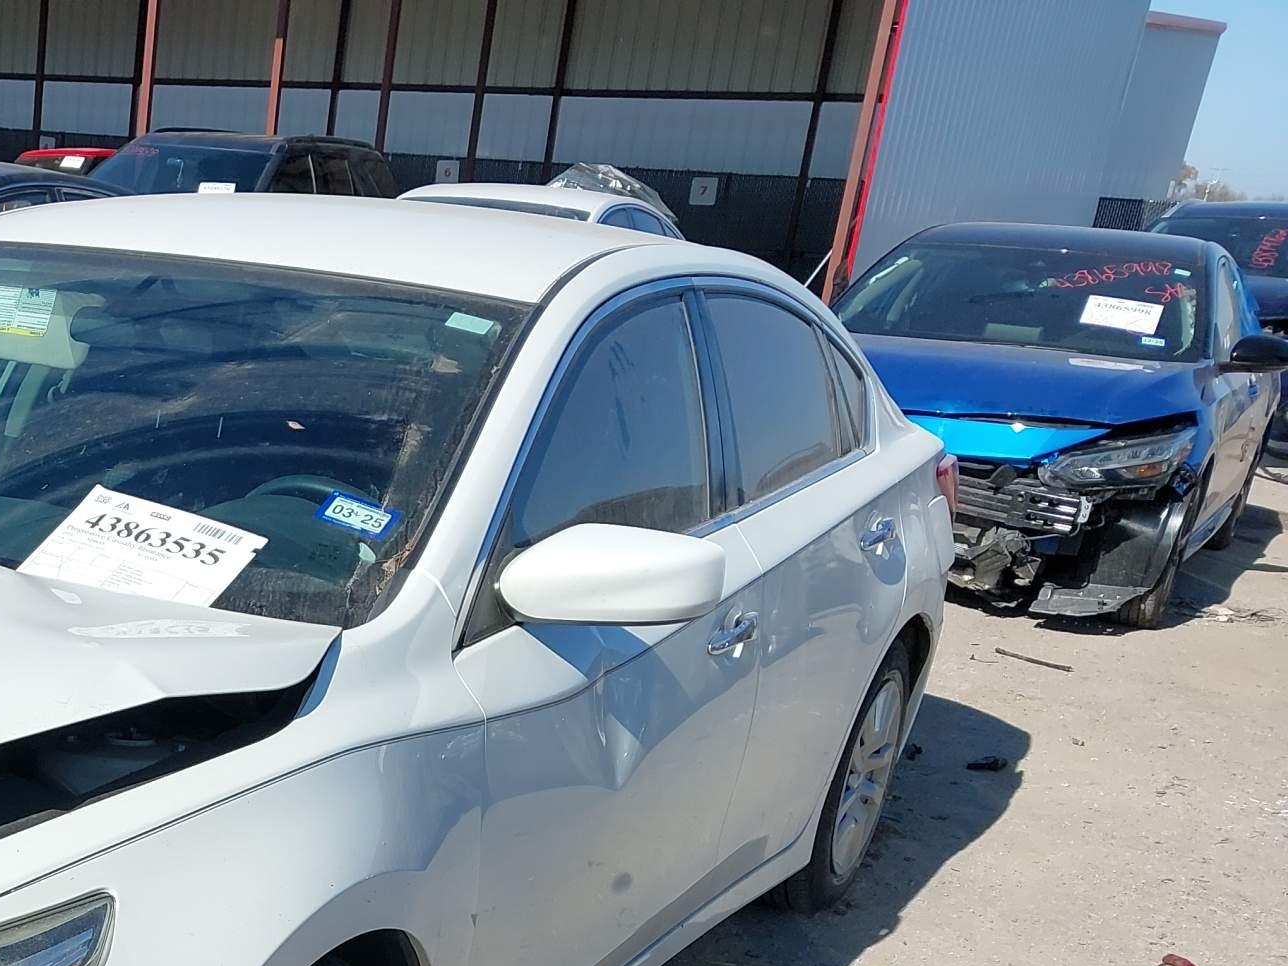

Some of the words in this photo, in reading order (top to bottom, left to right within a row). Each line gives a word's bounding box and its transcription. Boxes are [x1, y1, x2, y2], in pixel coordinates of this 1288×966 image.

[700, 184, 709, 196] 7
[360, 514, 385, 529] 25
[84, 513, 228, 566] 43863535
